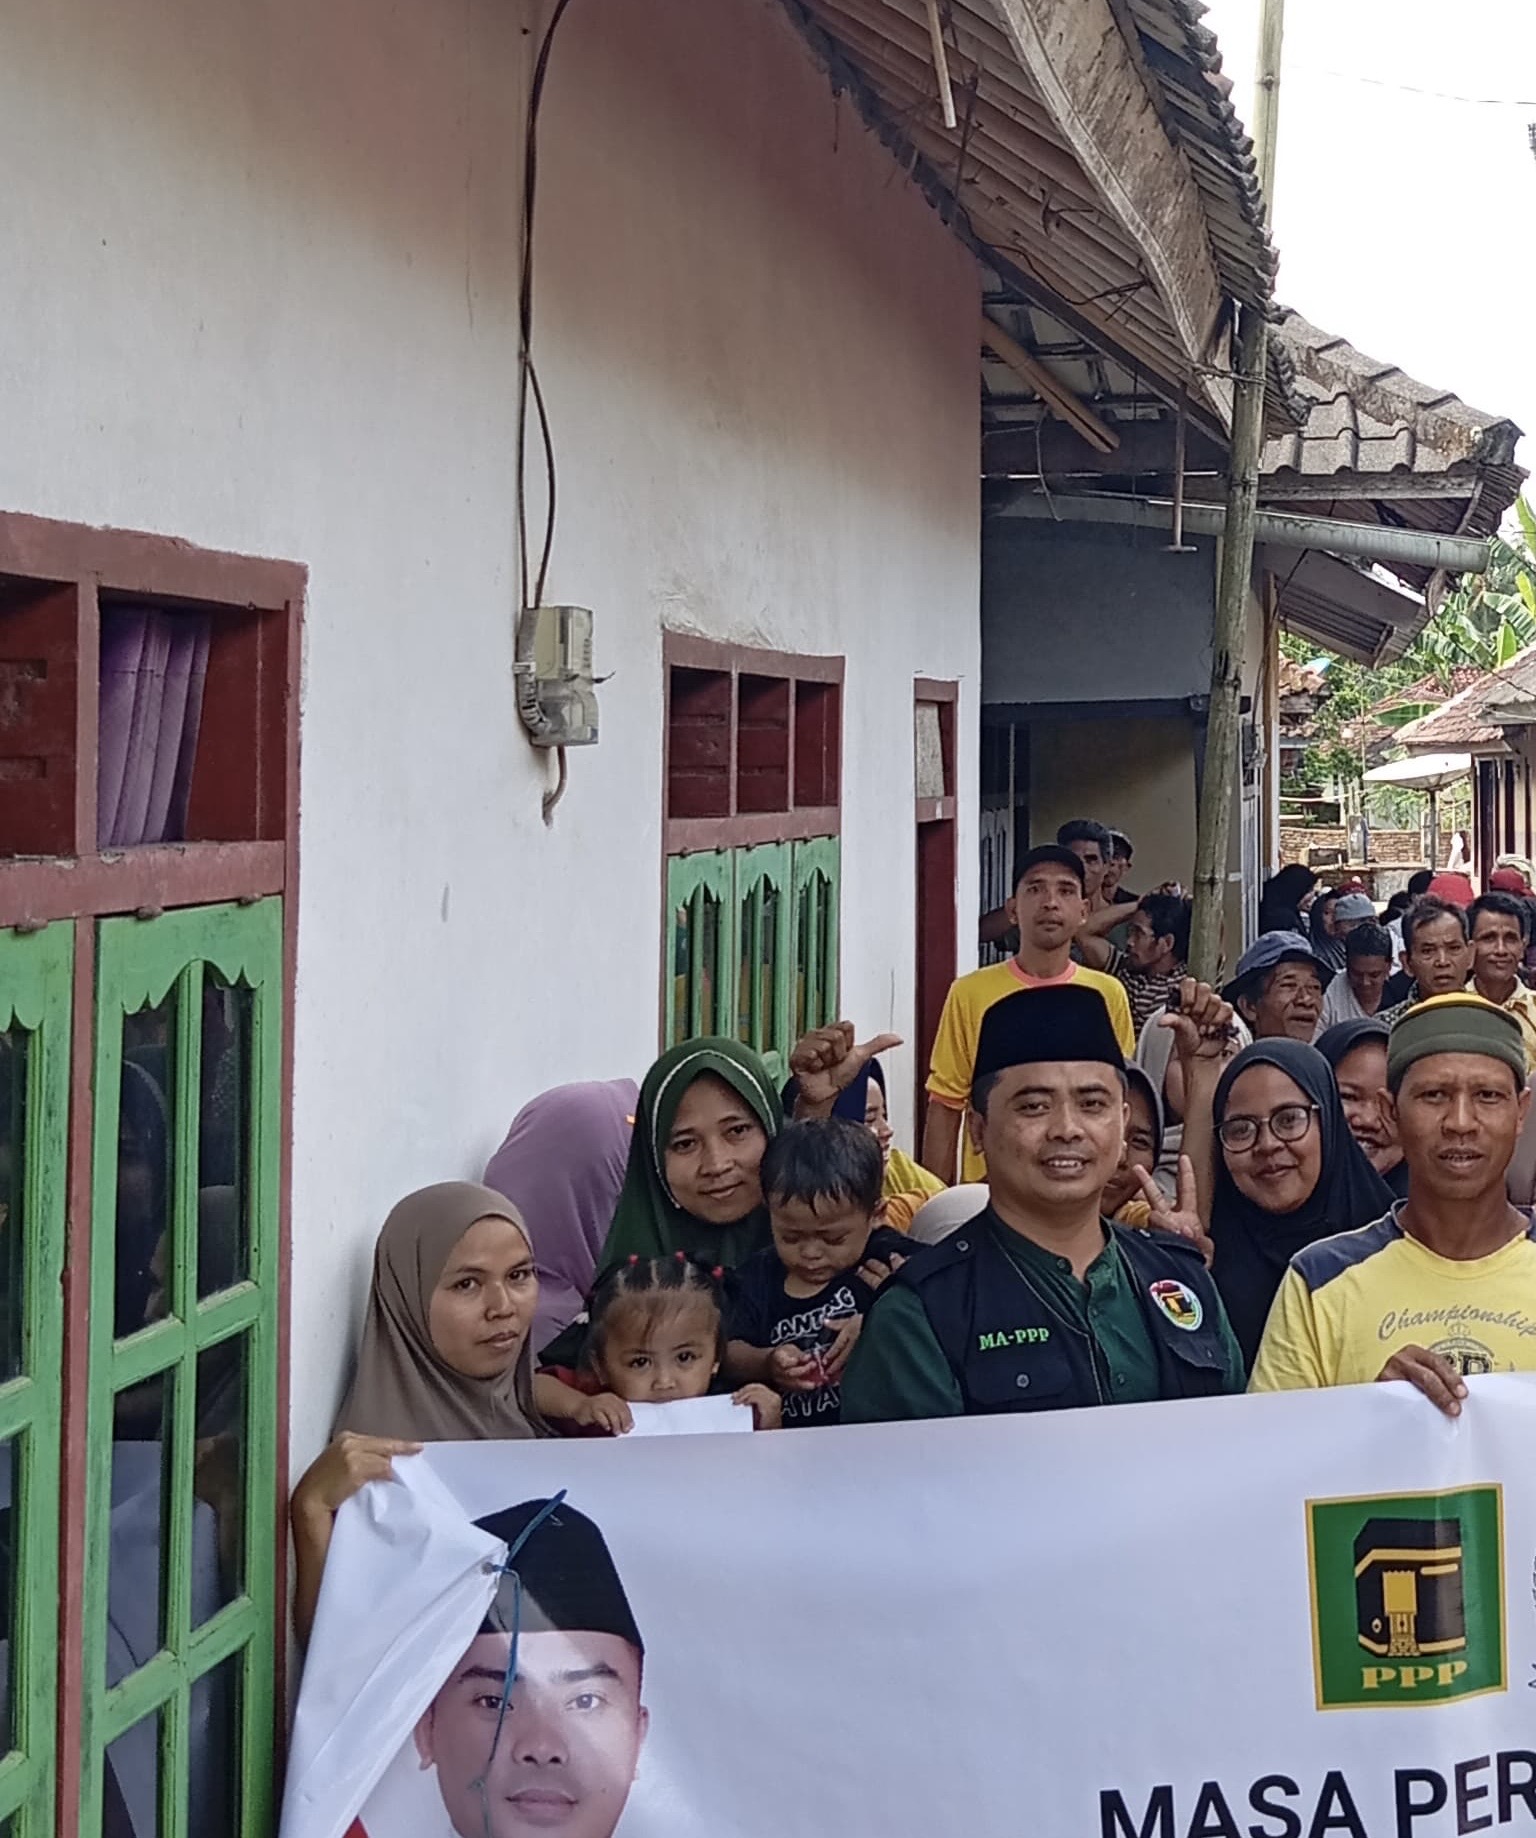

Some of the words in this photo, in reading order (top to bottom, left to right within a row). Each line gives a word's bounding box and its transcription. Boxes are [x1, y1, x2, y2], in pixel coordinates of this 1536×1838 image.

[979, 1327, 1050, 1351] MA-PPP
[1361, 1660, 1468, 1690] PPP
[1099, 1770, 1368, 1838] MASA
